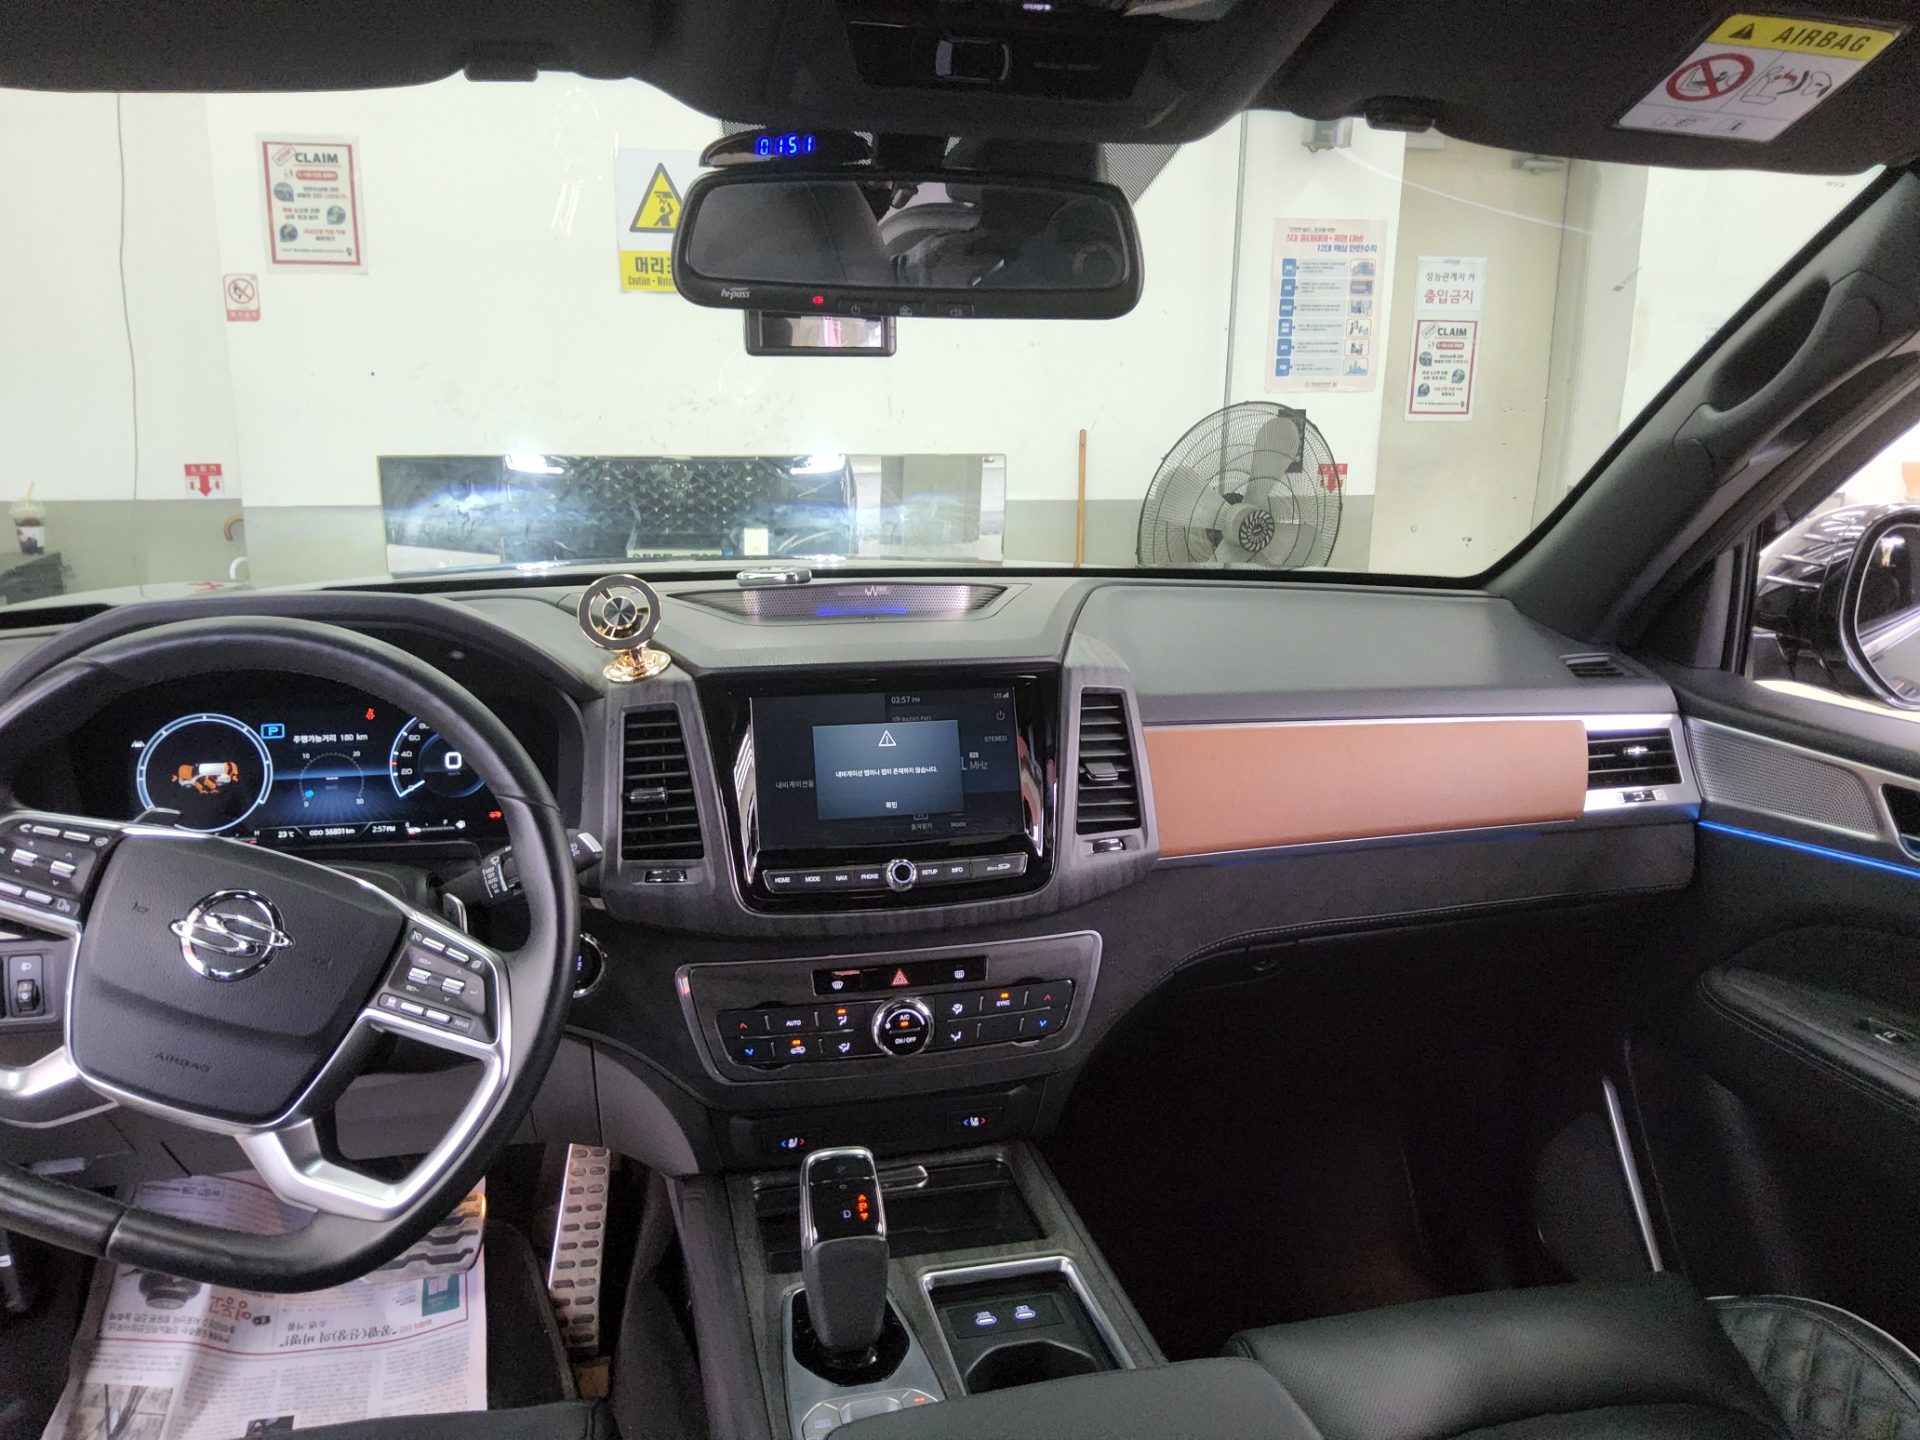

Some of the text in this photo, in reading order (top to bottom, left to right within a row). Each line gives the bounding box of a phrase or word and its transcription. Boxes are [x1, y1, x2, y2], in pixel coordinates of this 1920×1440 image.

[1772, 26, 1872, 53] AIRBAG
[295, 152, 339, 164] CLAIM
[635, 256, 672, 274] 머리
[1424, 288, 1474, 305] 출입금지
[1437, 327, 1467, 337] CLAIM
[891, 696, 911, 704] 02:57
[268, 727, 279, 736] P
[292, 733, 368, 744] 주행가능거리 180 km
[445, 752, 462, 769] 0
[969, 761, 989, 770] MHz
[835, 770, 863, 778] 내비게이션
[893, 767, 915, 775] 존재하지
[915, 766, 939, 774] 않습니다.
[885, 801, 898, 809] 확인
[278, 830, 288, 839] 23
[835, 874, 848, 882] NAVI
[995, 998, 1011, 1007] SYNC
[454, 1019, 470, 1029] NAVI
[785, 1019, 802, 1027] AUTO
[154, 1051, 213, 1073] AIRBAG
[842, 1209, 852, 1219] D
